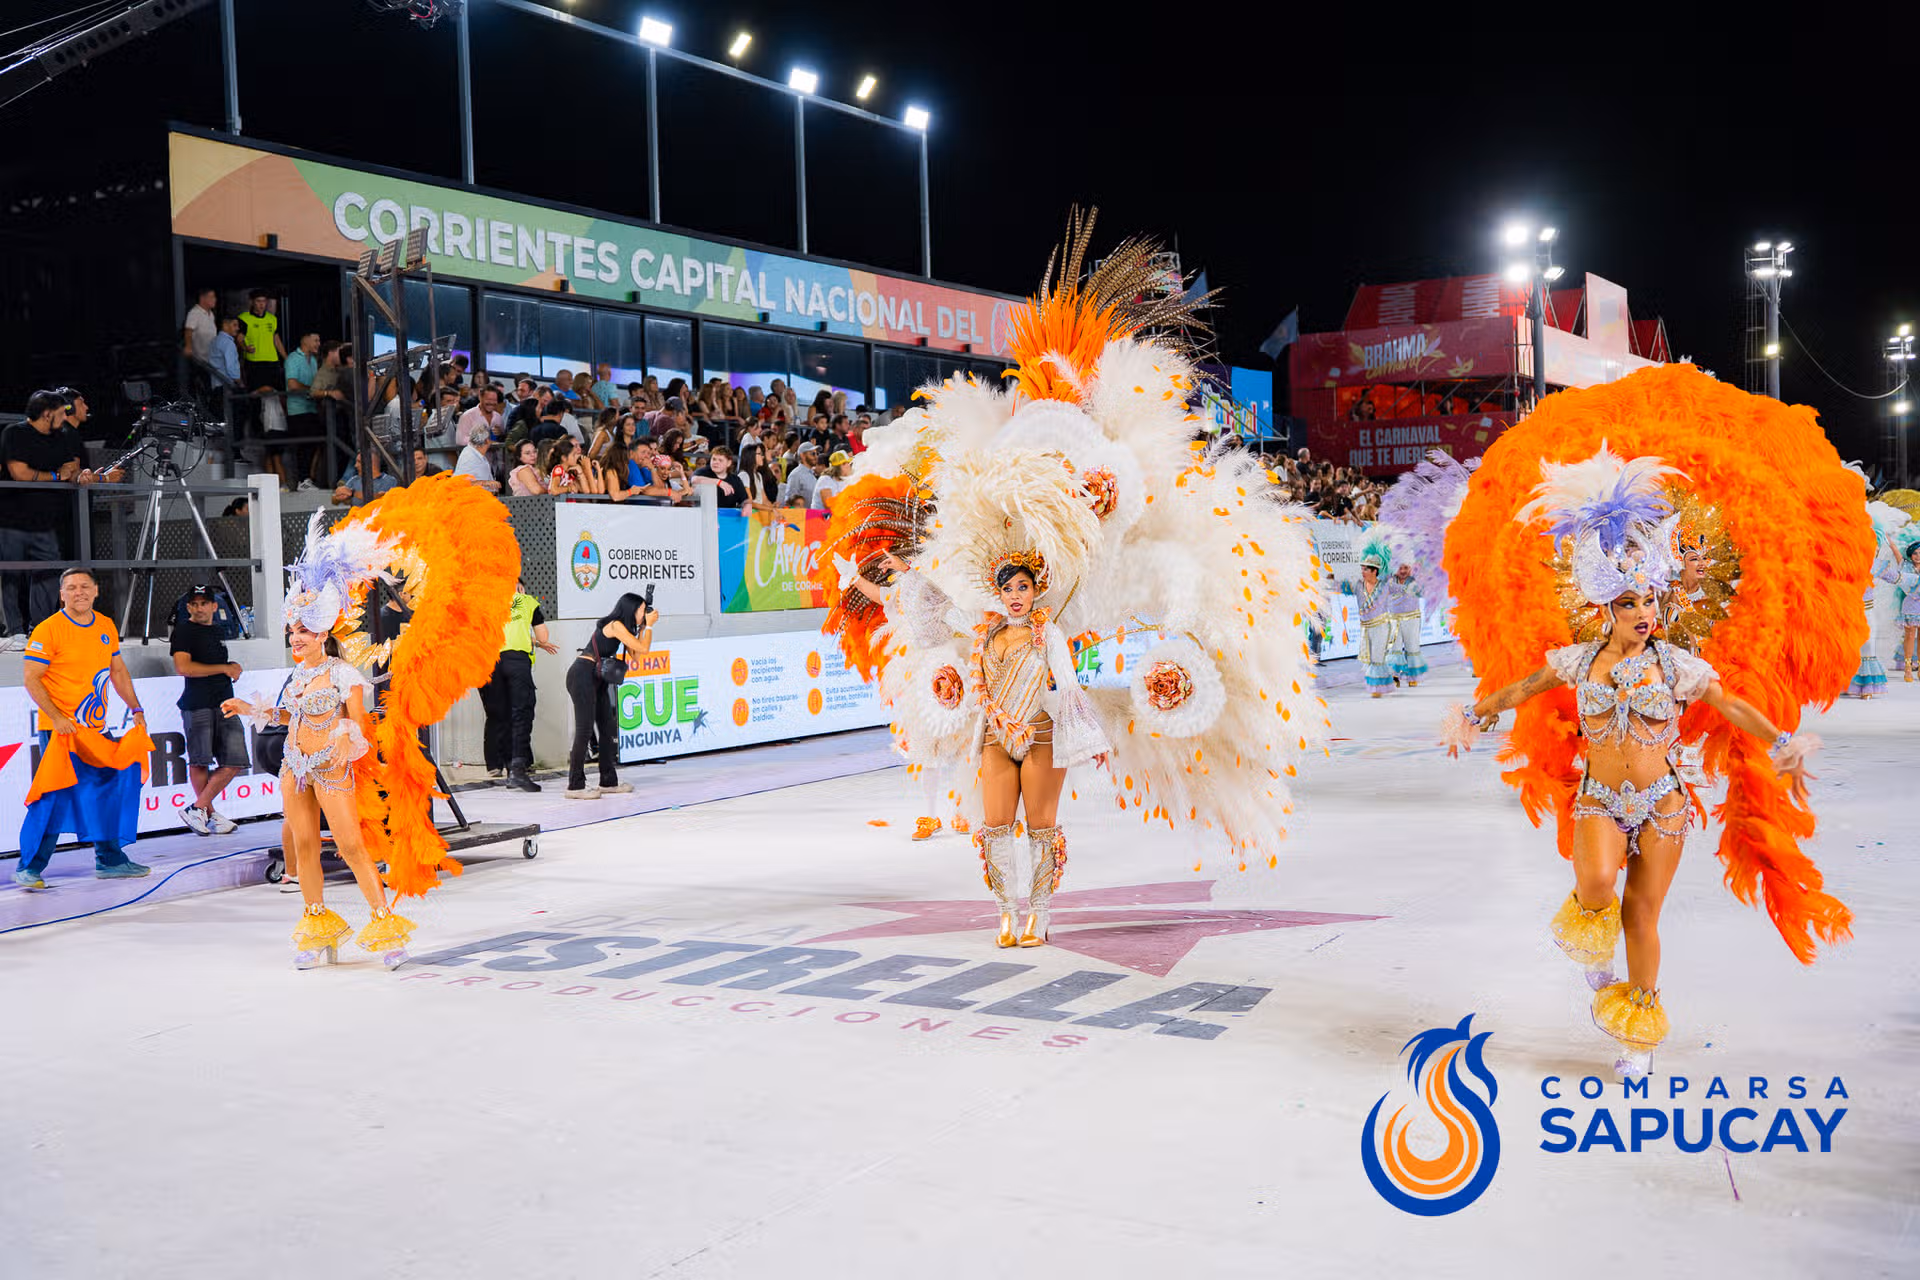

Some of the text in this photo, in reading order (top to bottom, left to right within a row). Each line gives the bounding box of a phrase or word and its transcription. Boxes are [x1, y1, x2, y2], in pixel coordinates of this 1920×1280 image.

[333, 191, 620, 285] CORRIENTES
[630, 248, 777, 311] CAPITAL
[784, 277, 931, 337] NACIONAL
[936, 305, 984, 345] DEL
[1364, 333, 1426, 369] BRAHMA
[1359, 425, 1441, 446] EL CARNAVAL
[1349, 448, 1374, 466] QUE
[1376, 447, 1391, 465] TE
[608, 548, 678, 561] GOBIERNO DE
[608, 563, 695, 580] CORRIENTES
[782, 581, 793, 591] DE
[643, 656, 668, 670] HAY
[618, 676, 699, 730] GUE
[408, 930, 1274, 1041] ESTRELLA
[400, 972, 1089, 1049] PRODUCCIONES
